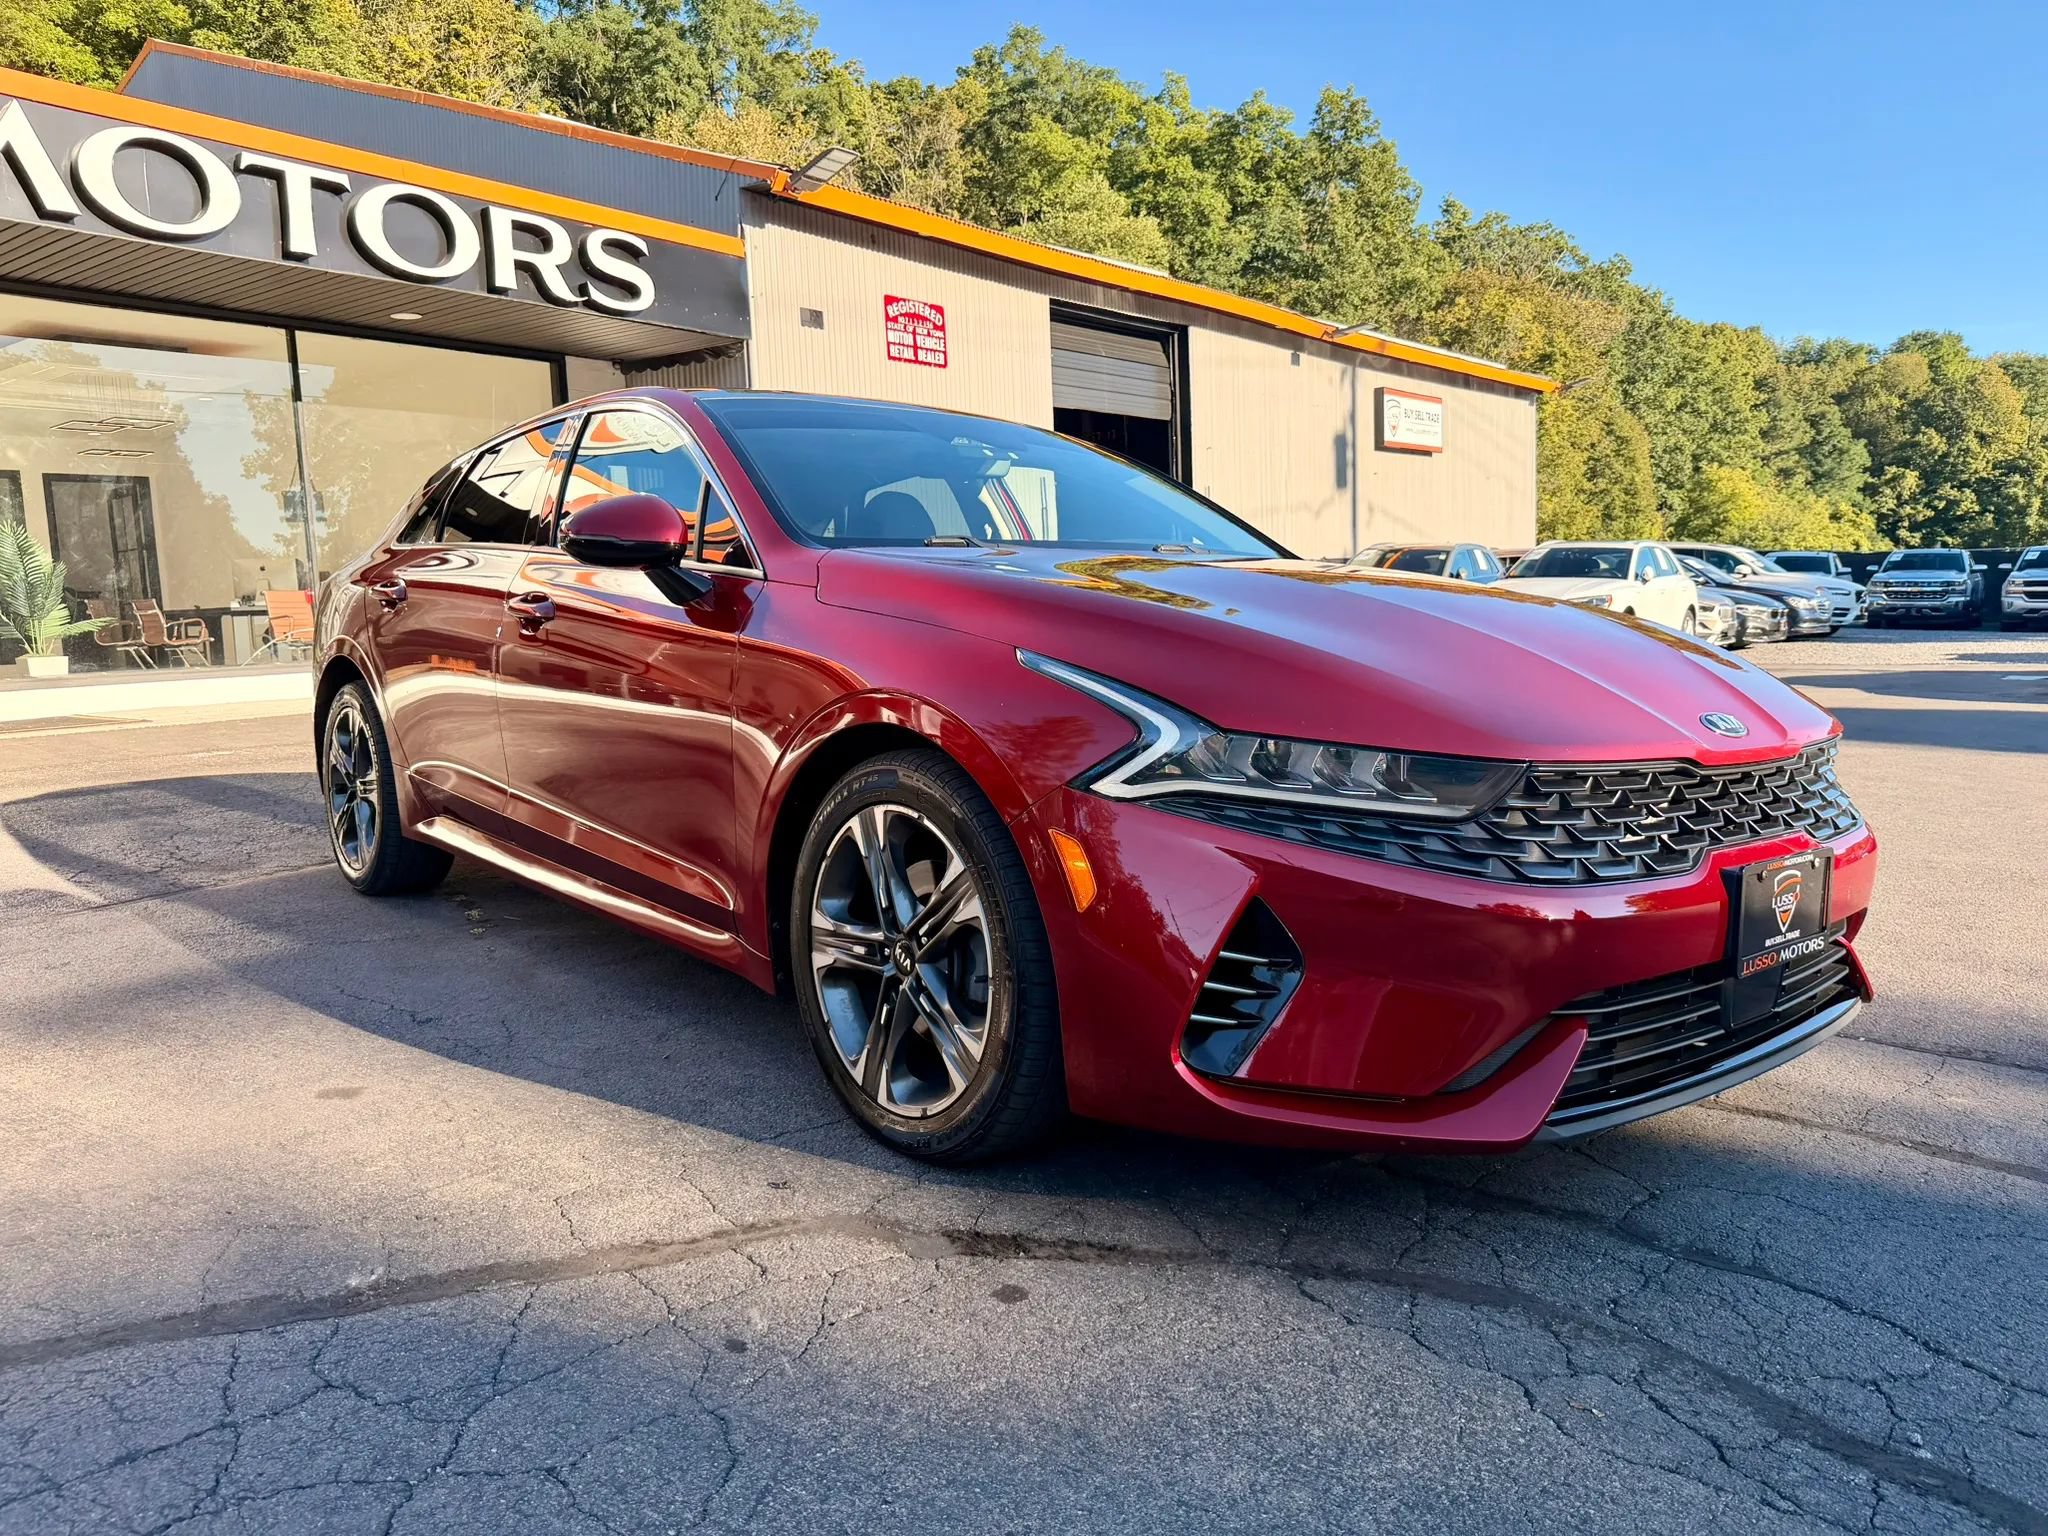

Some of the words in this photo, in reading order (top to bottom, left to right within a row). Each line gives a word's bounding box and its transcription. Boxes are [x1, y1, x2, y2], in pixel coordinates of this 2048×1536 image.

[886, 300, 943, 326] REGISTERED
[887, 321, 905, 331] STATE
[906, 325, 914, 333] OF
[888, 330, 914, 346] MOTOR
[915, 334, 945, 351] VEHICLE
[889, 343, 915, 360] RETAIL
[917, 348, 945, 365] DEALER
[1772, 891, 1800, 908] LUSSO
[1743, 952, 1777, 975] LUSSO
[1779, 936, 1825, 961] MOTORS
